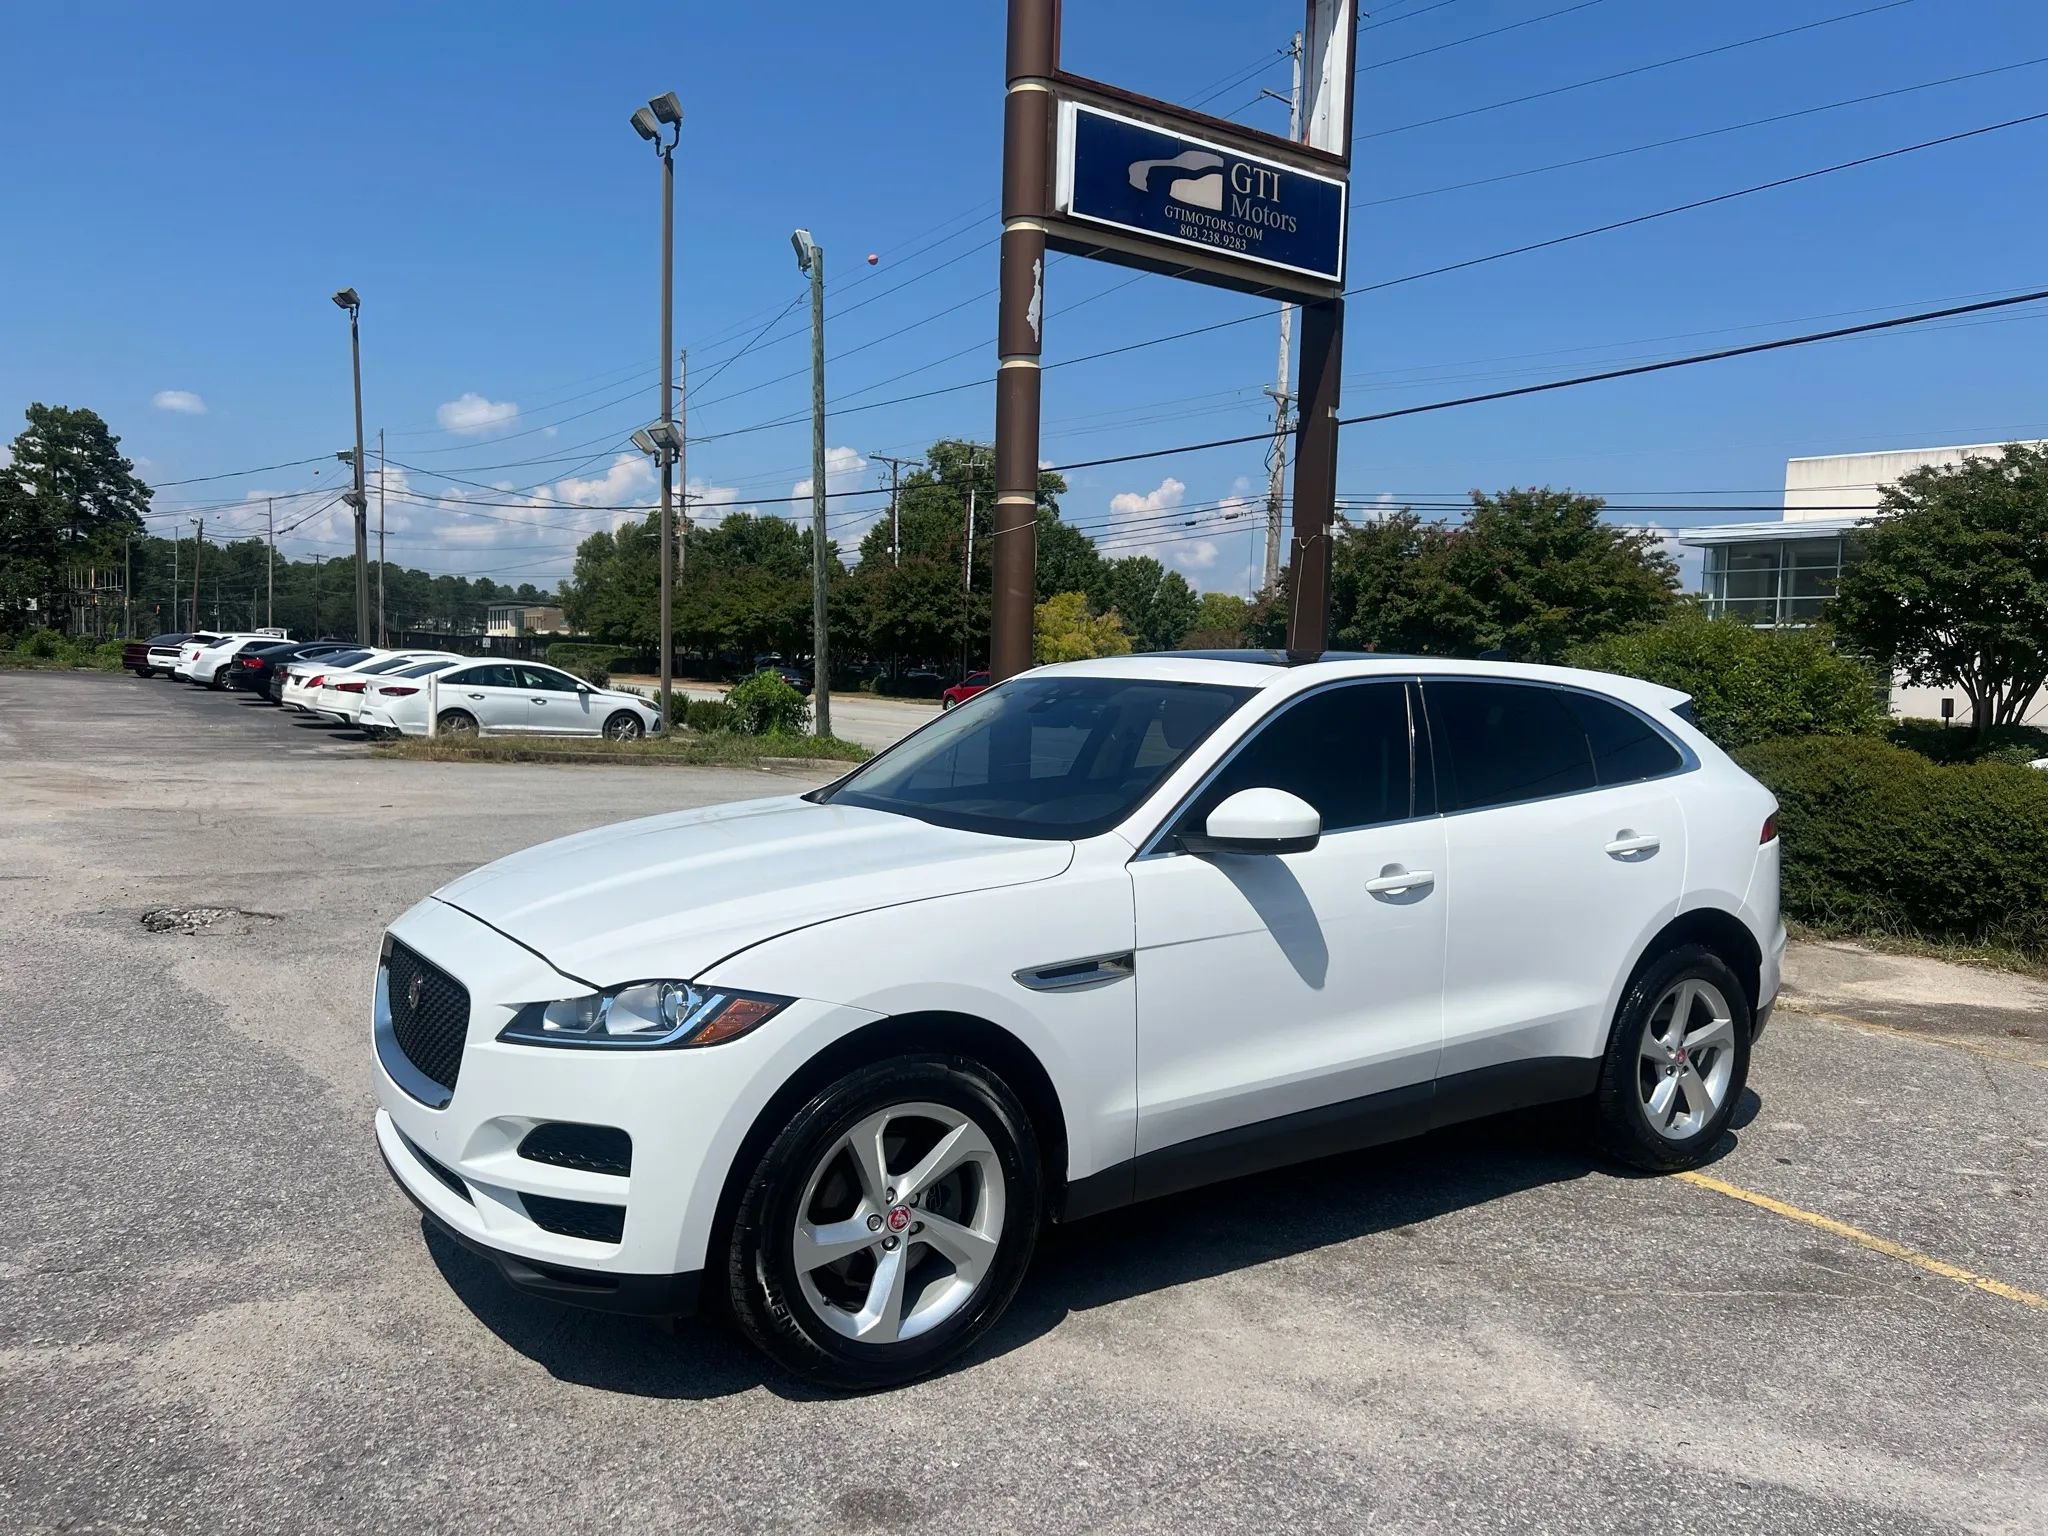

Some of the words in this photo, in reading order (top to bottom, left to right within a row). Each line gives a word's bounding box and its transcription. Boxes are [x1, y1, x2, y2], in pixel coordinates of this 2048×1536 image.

[1231, 163, 1281, 203] GTI
[1164, 205, 1263, 241] GTIMOTORS.COM
[1231, 194, 1297, 233] Motors
[1180, 224, 1247, 250] 803.238.9283
